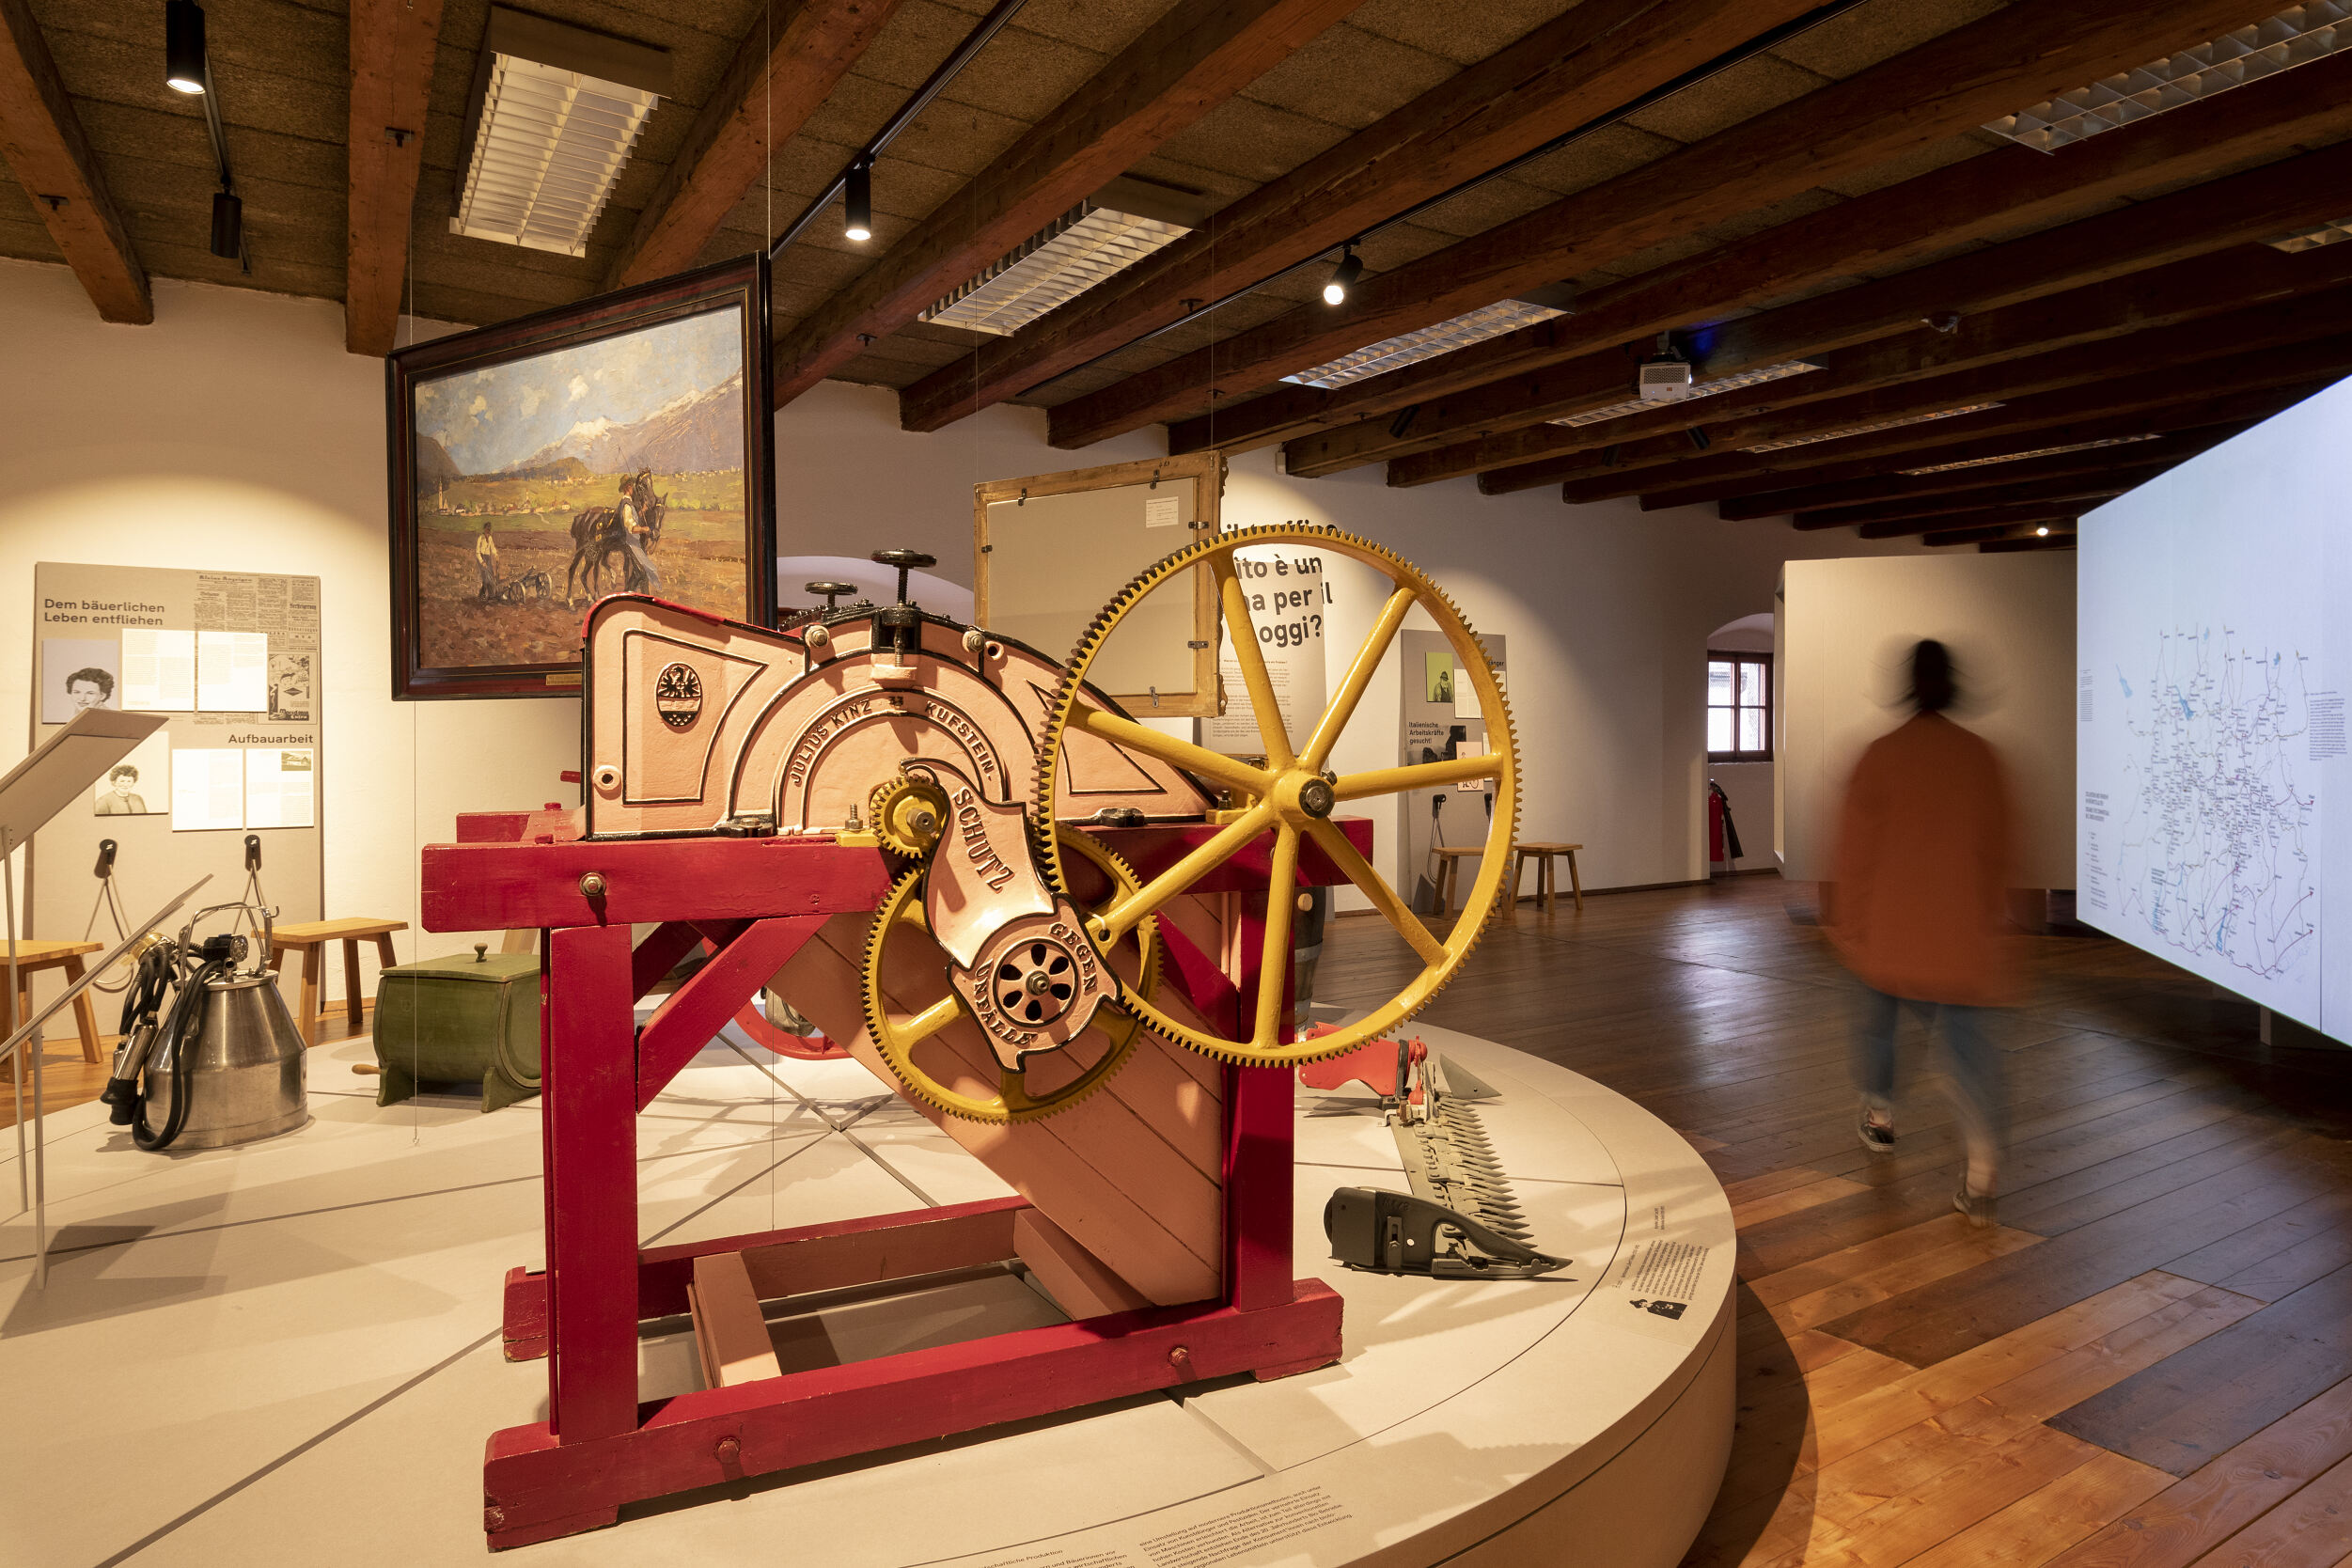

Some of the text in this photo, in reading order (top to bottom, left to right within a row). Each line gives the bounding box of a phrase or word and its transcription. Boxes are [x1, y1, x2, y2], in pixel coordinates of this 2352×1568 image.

[1274, 554, 1288, 576] è
[1294, 557, 1323, 574] un
[44, 598, 165, 613] Dem bäuerlichen
[1274, 589, 1312, 615] per
[1321, 582, 1333, 604] il
[44, 612, 164, 626] Leben entfliehen
[1260, 614, 1323, 648] oggi?
[227, 733, 314, 744] Aufbauarbeit
[790, 724, 828, 786] JULIUS
[830, 698, 872, 727] KINZ
[951, 786, 1015, 894] SCHUTZ
[1048, 921, 1098, 996] GEGEN
[973, 958, 1039, 1047] UNFÄLLE
[1143, 1542, 1164, 1552] Einsatz
[1179, 1526, 1215, 1541] Kunstdünger
[1152, 1529, 1186, 1543] Umstellung
[1152, 1553, 1172, 1562] hohen
[1173, 1545, 1195, 1556] Kosten
[1242, 1519, 1274, 1533] Alternative
[1157, 1549, 1202, 1568] Landwirtschaft
[1203, 1540, 1232, 1553] entstehen
[1271, 1514, 1309, 1530] Jahrhunderts
[1161, 1539, 1195, 1553] Maschinen
[1196, 1528, 1228, 1542] erleichtert
[1227, 1542, 1268, 1559] Lebensmitteln
[1270, 1530, 1301, 1544] unterstützt
[1027, 1549, 1062, 1560] Produktion
[1209, 1544, 1241, 1558] Nachfrage
